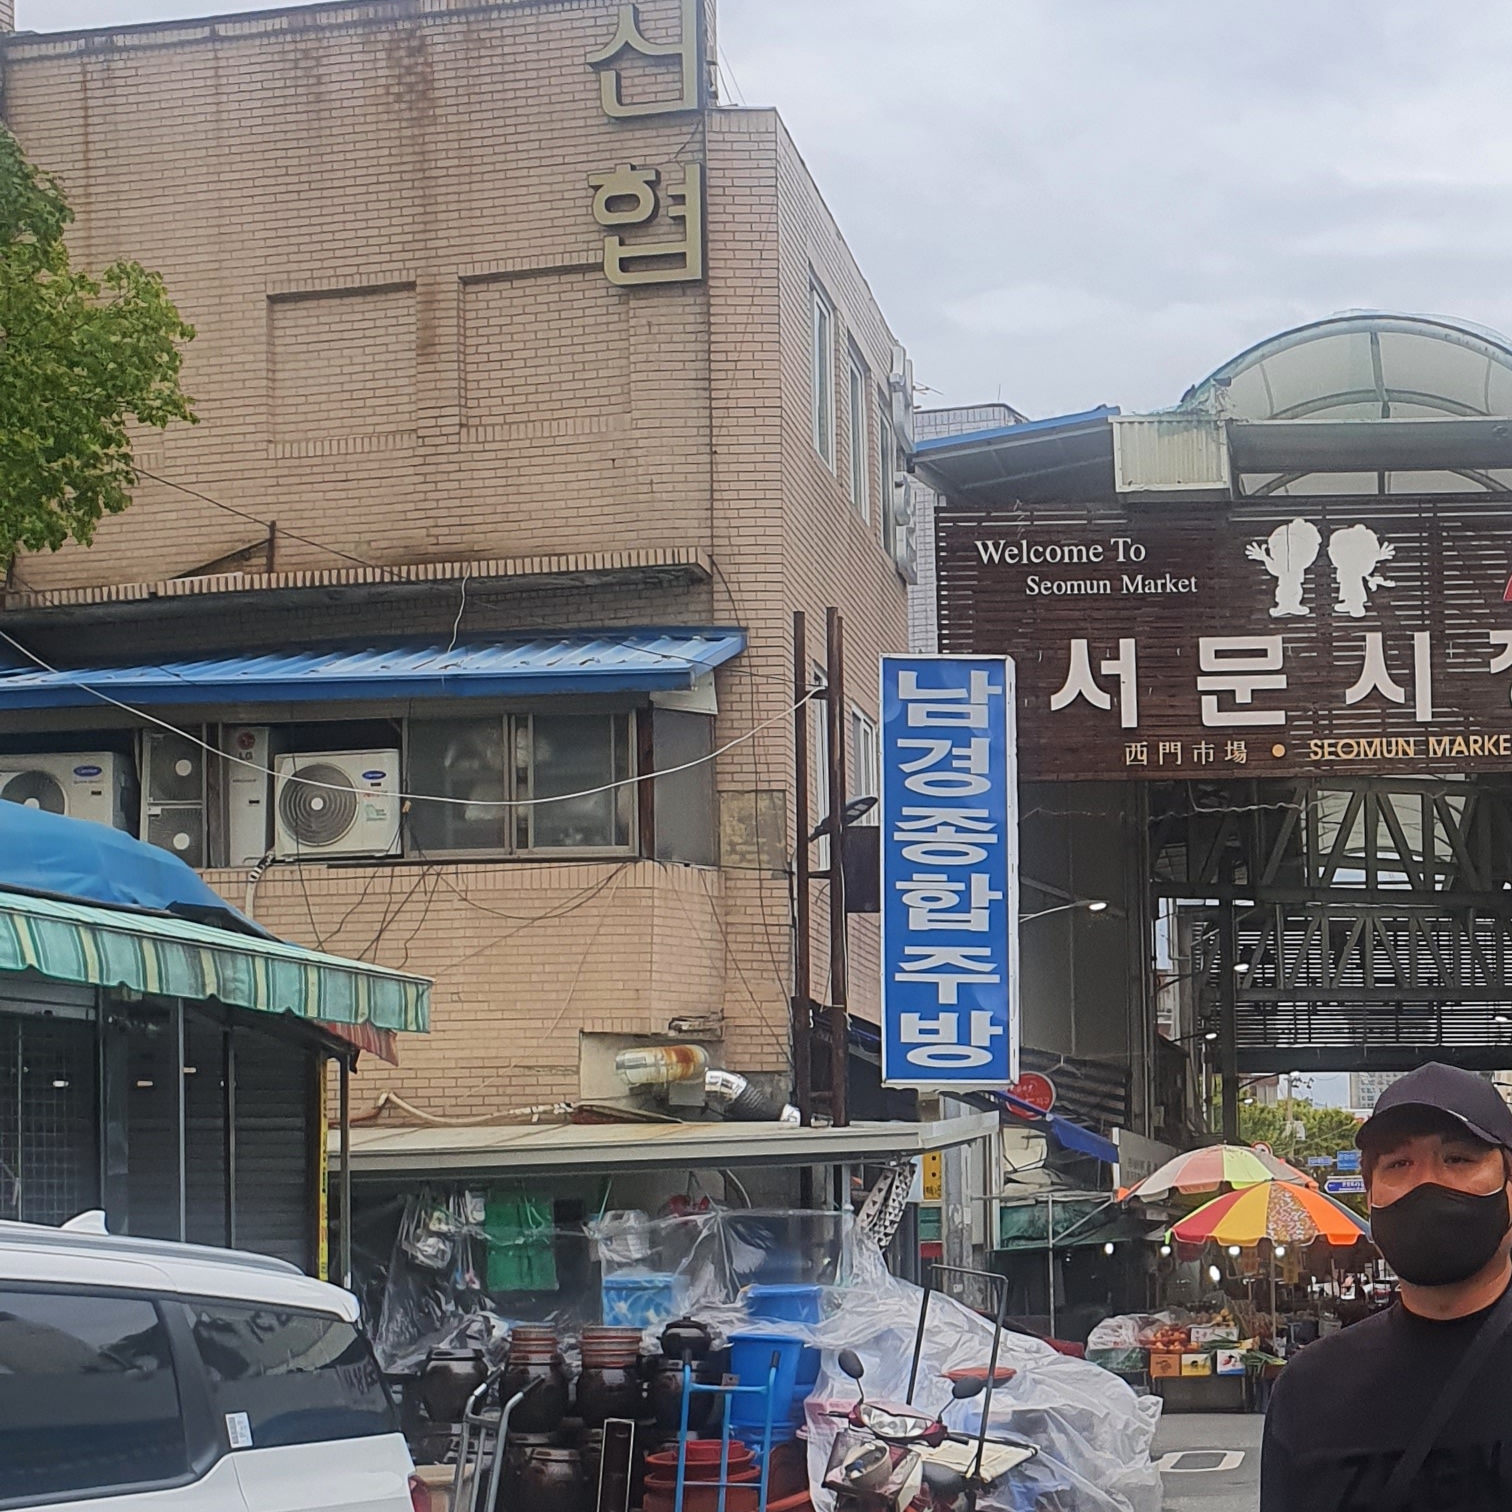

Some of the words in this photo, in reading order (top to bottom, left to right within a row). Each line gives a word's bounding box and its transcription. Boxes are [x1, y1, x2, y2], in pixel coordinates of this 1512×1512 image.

[974, 539, 1104, 564] Welcome
[1110, 537, 1146, 562] To
[1026, 575, 1111, 595] Seomun
[1121, 572, 1198, 593] Market
[1125, 741, 1248, 766] 西門市場
[1309, 738, 1414, 760] SEOMUN
[893, 669, 1003, 1068] 남경종합주방
